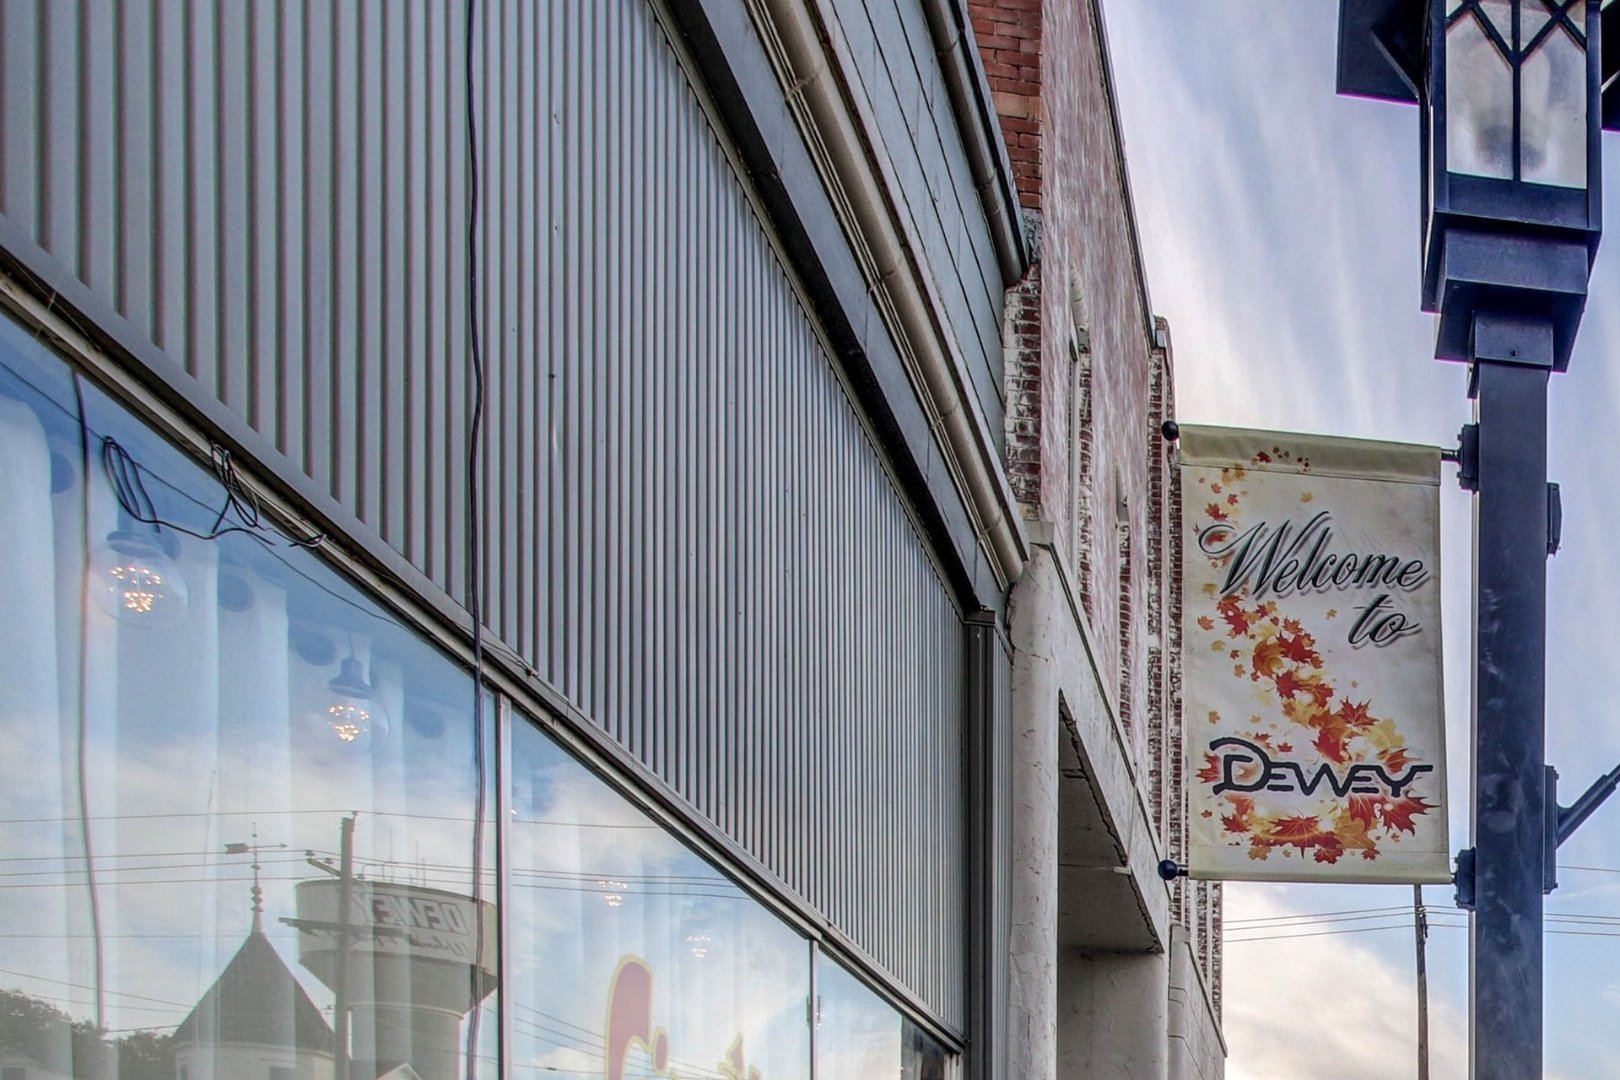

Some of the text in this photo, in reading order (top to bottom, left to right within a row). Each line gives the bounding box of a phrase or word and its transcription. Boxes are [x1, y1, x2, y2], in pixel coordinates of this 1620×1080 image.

[1197, 510, 1429, 596] Welcome
[1347, 593, 1422, 646] to
[1209, 736, 1433, 799] DEWEY
